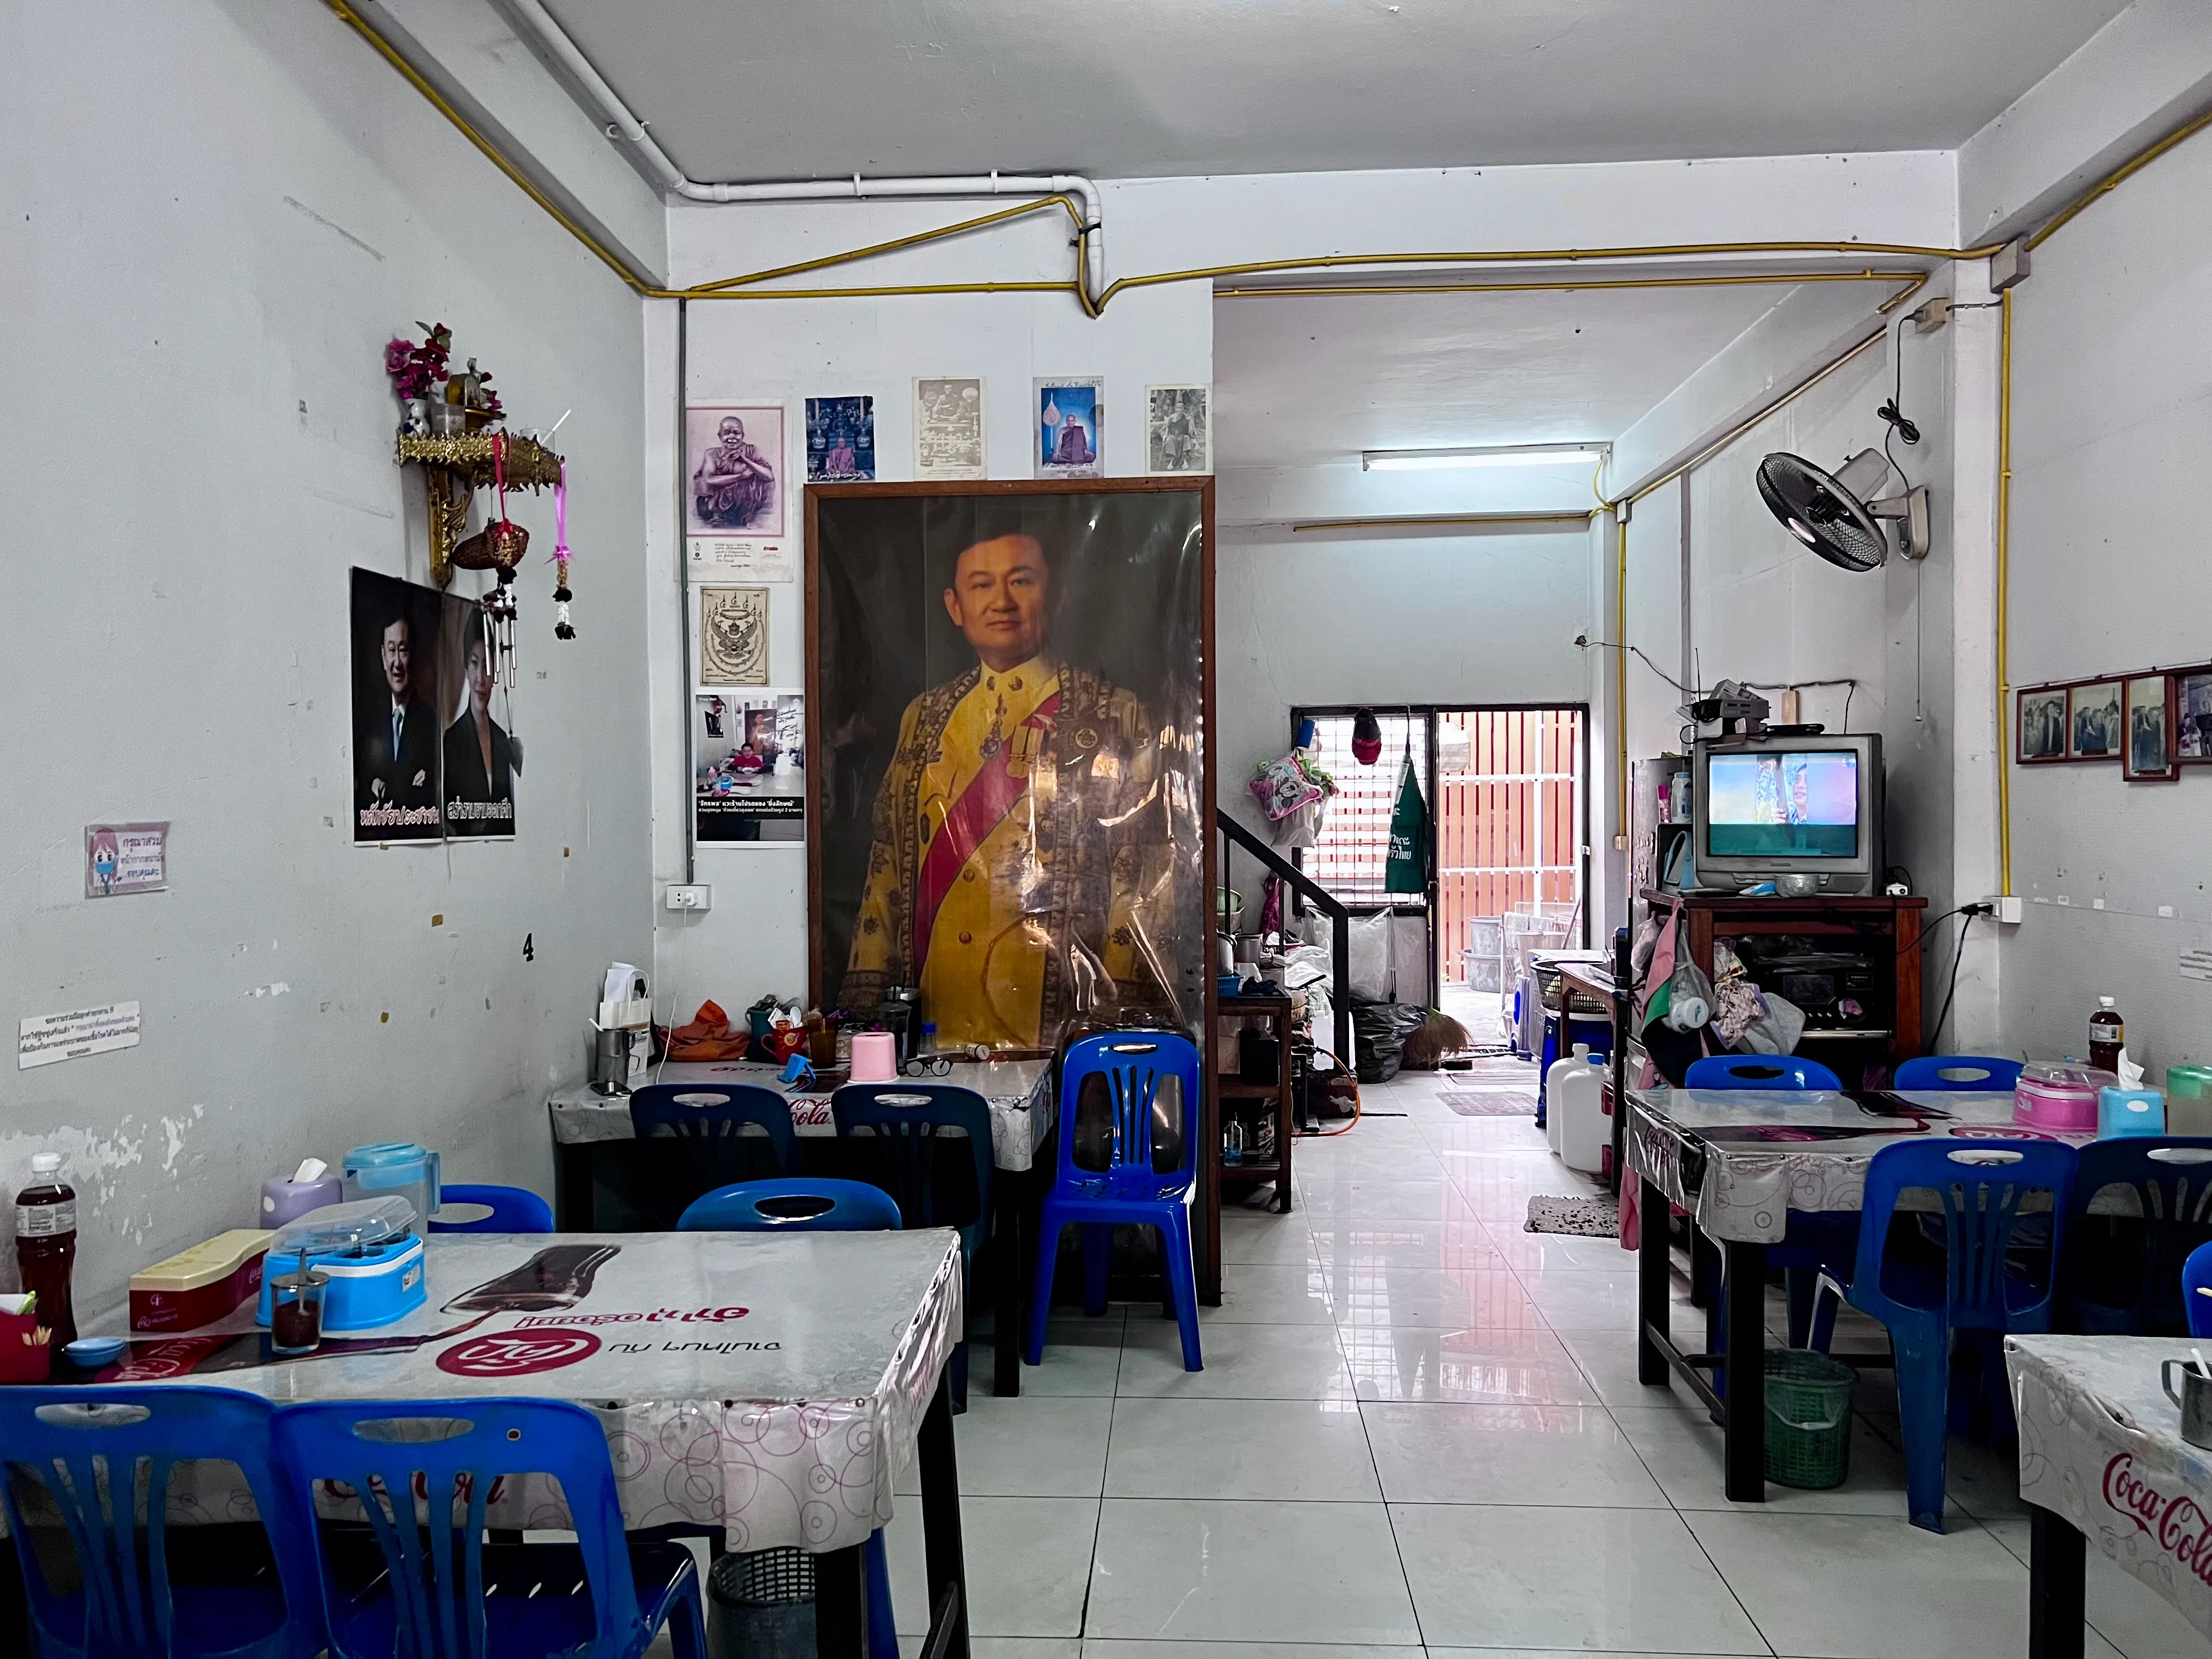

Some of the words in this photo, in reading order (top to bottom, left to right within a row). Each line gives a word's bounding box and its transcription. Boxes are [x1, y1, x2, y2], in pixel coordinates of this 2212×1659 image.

[360, 799, 439, 826] หลักชัยประชาชน
